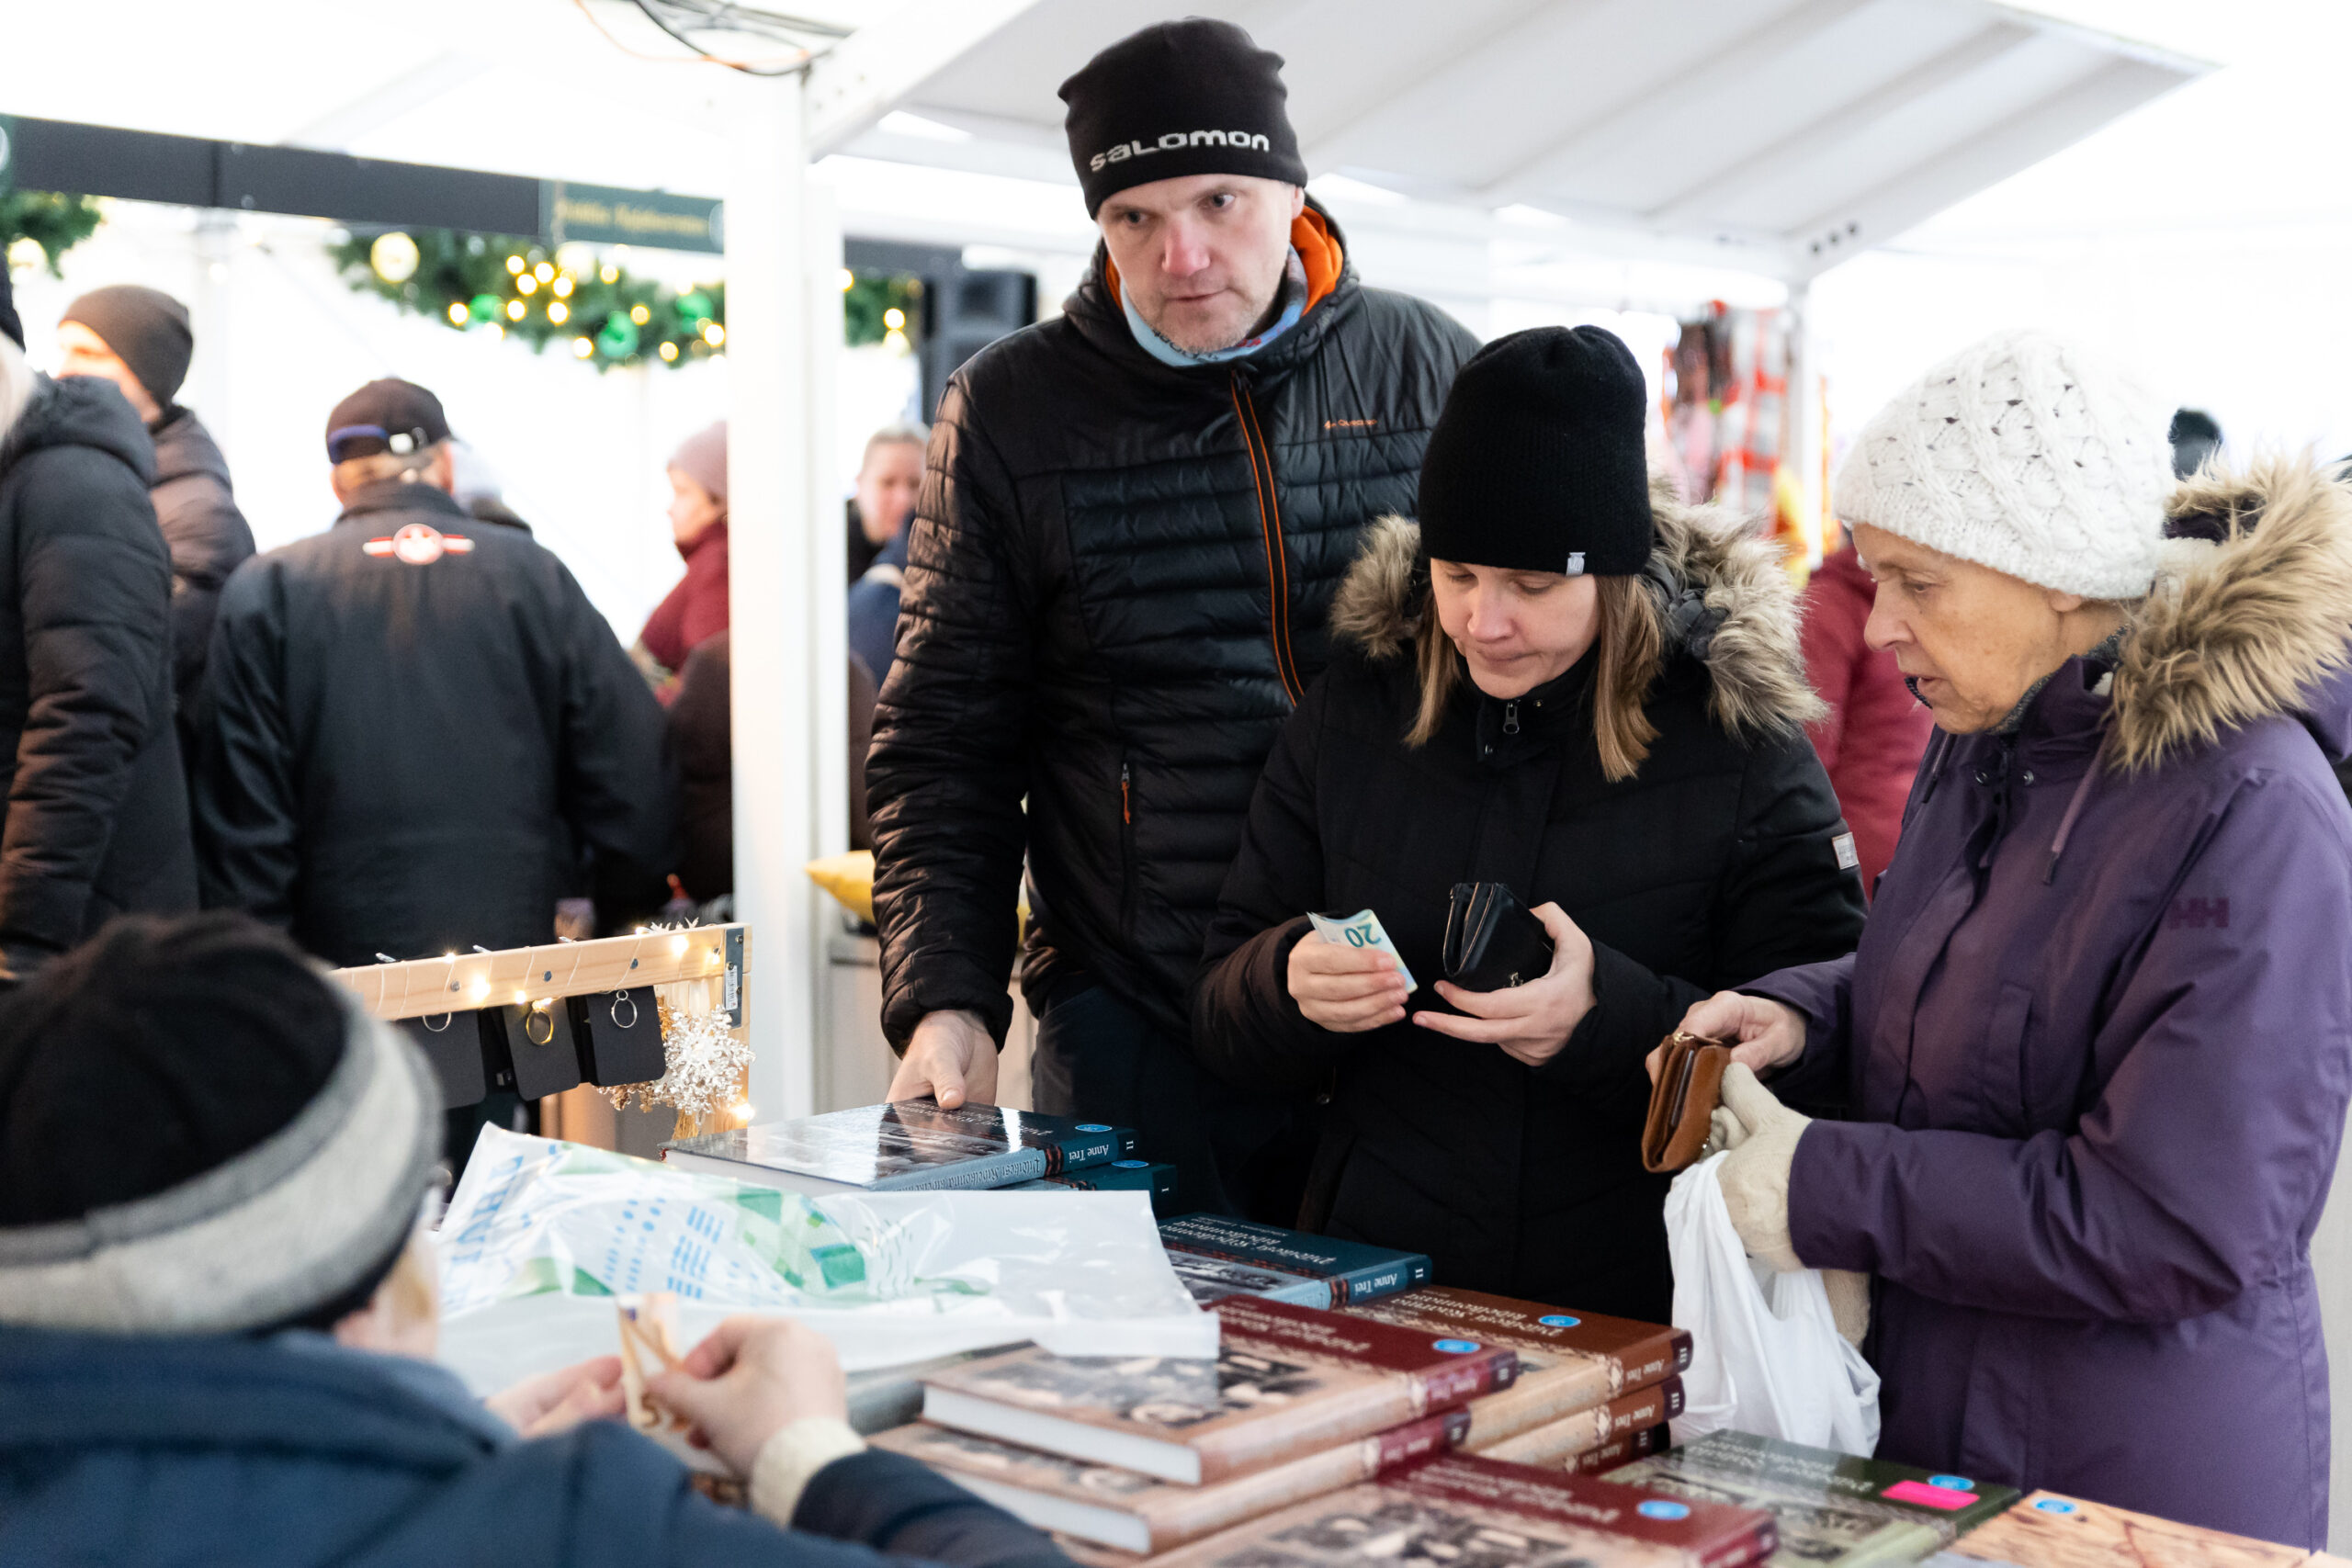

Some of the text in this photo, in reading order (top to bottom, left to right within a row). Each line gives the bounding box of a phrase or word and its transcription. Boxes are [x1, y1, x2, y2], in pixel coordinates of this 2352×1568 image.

[1344, 923, 1381, 948] 20
[1069, 1144, 1110, 1165] Anne Trei
[1354, 1273, 1397, 1295] Anne Trei
[1643, 1359, 1665, 1374] Anne
[1633, 1404, 1656, 1420] Anne
